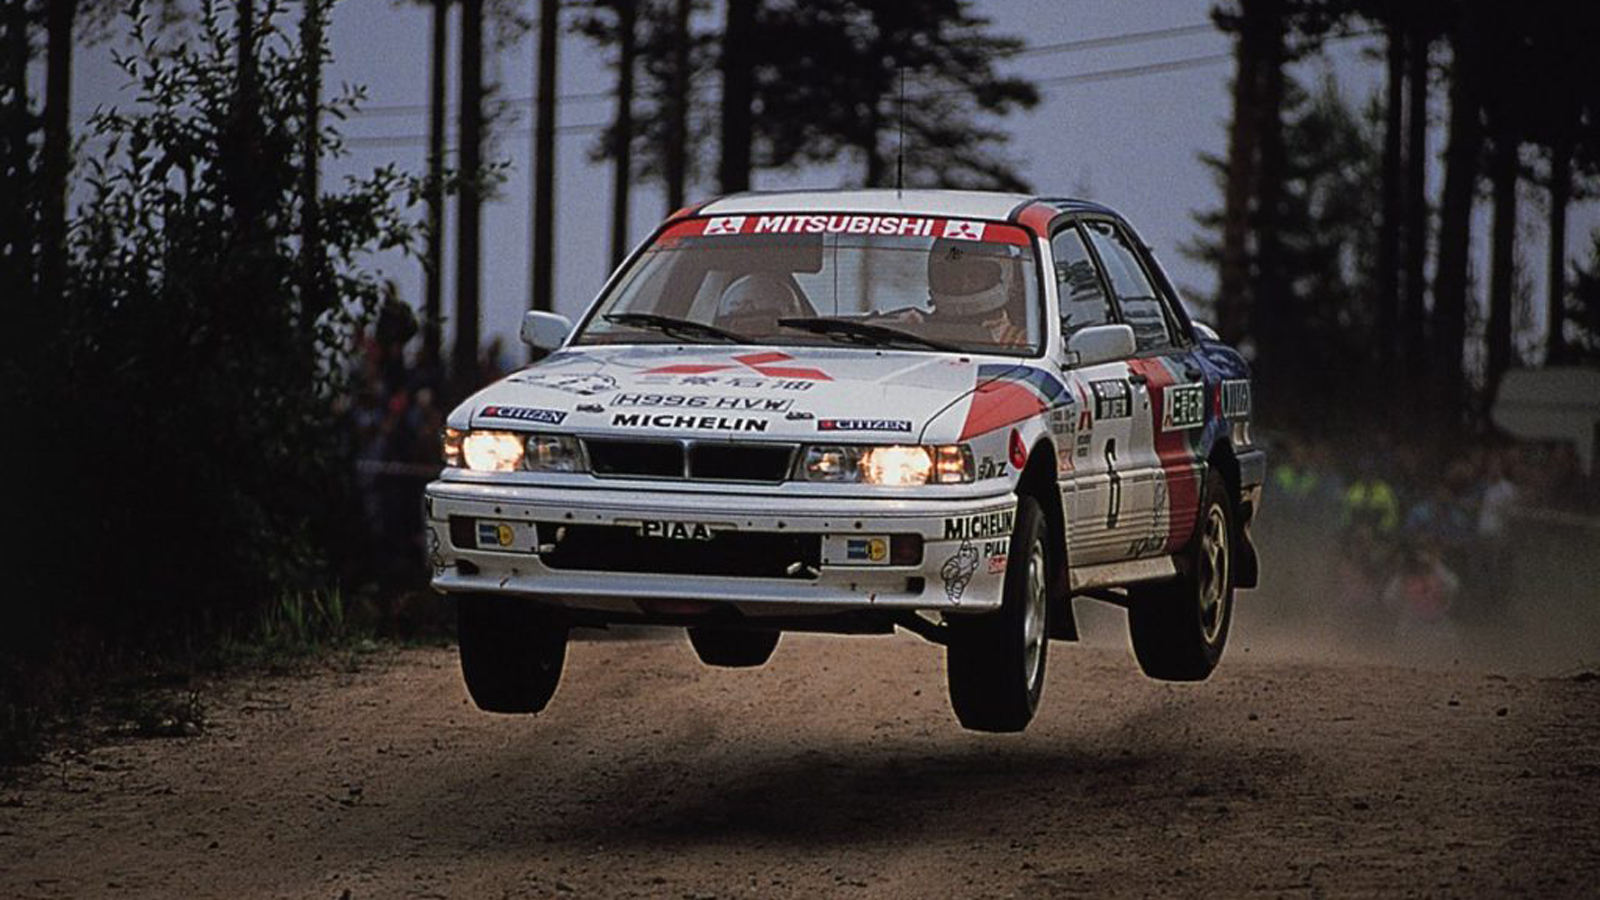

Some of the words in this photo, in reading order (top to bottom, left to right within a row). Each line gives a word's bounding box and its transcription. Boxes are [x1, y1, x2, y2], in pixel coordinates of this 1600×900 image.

[753, 215, 934, 236] MITSUBISHI
[616, 394, 709, 408] H996
[497, 407, 563, 424] CITIZEN
[612, 413, 769, 432] MICHELIN
[835, 420, 910, 431] CITIZEN
[642, 520, 714, 540] PIAA
[944, 510, 1014, 540] MICHELIN
